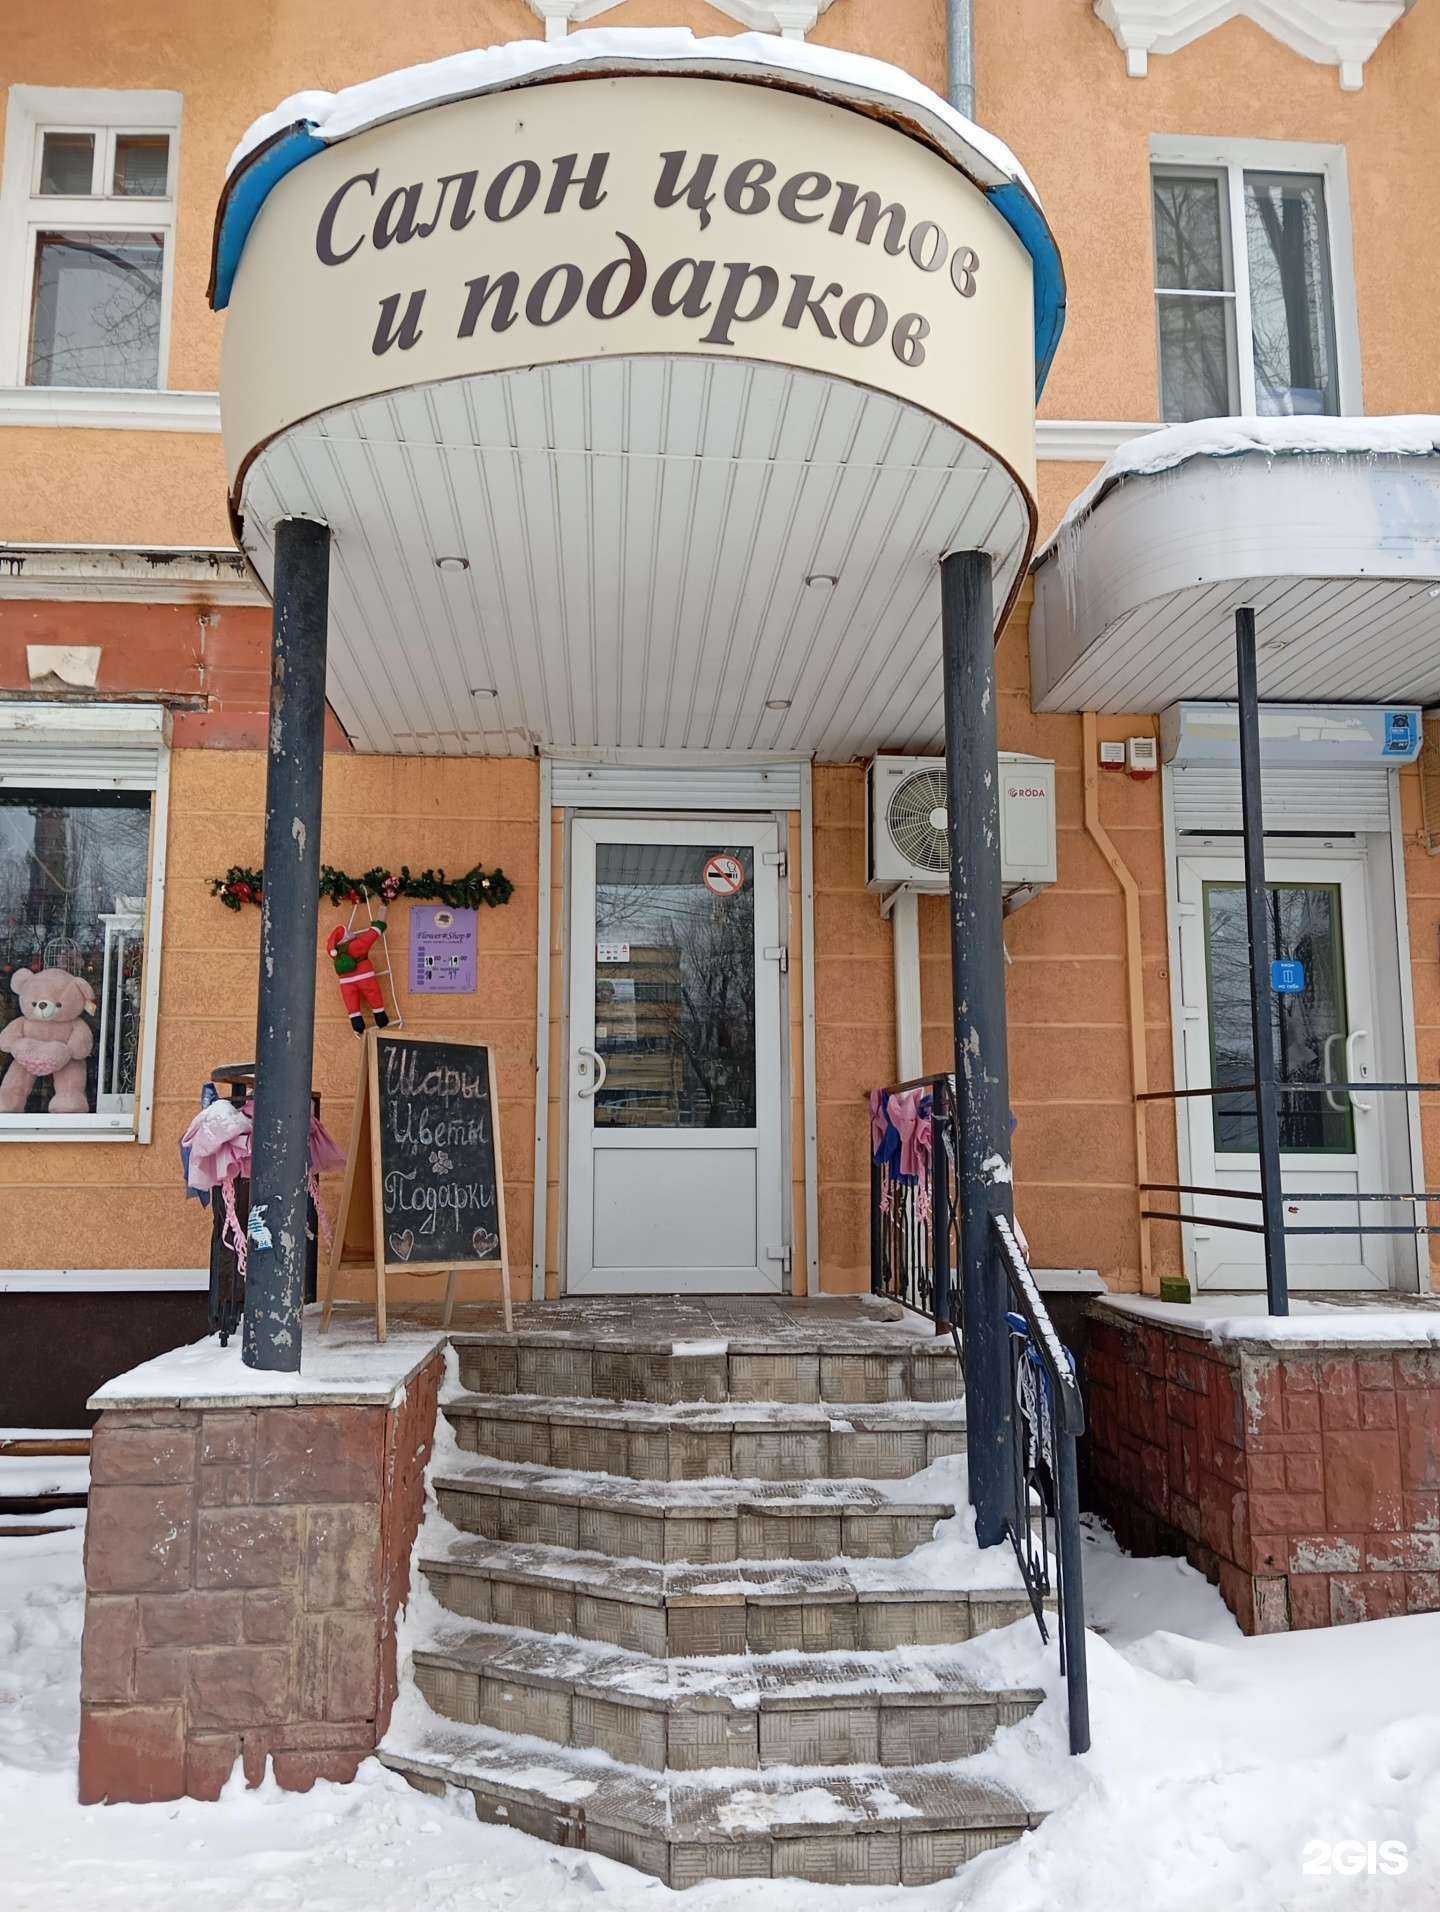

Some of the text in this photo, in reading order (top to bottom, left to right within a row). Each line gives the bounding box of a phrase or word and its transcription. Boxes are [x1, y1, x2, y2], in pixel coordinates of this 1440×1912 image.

[316, 150, 980, 298] Салон цветов
[372, 231, 931, 367] и подарков
[385, 1046, 487, 1108] Шары
[386, 1100, 489, 1155] Цветы
[384, 1169, 494, 1234] Подарки
